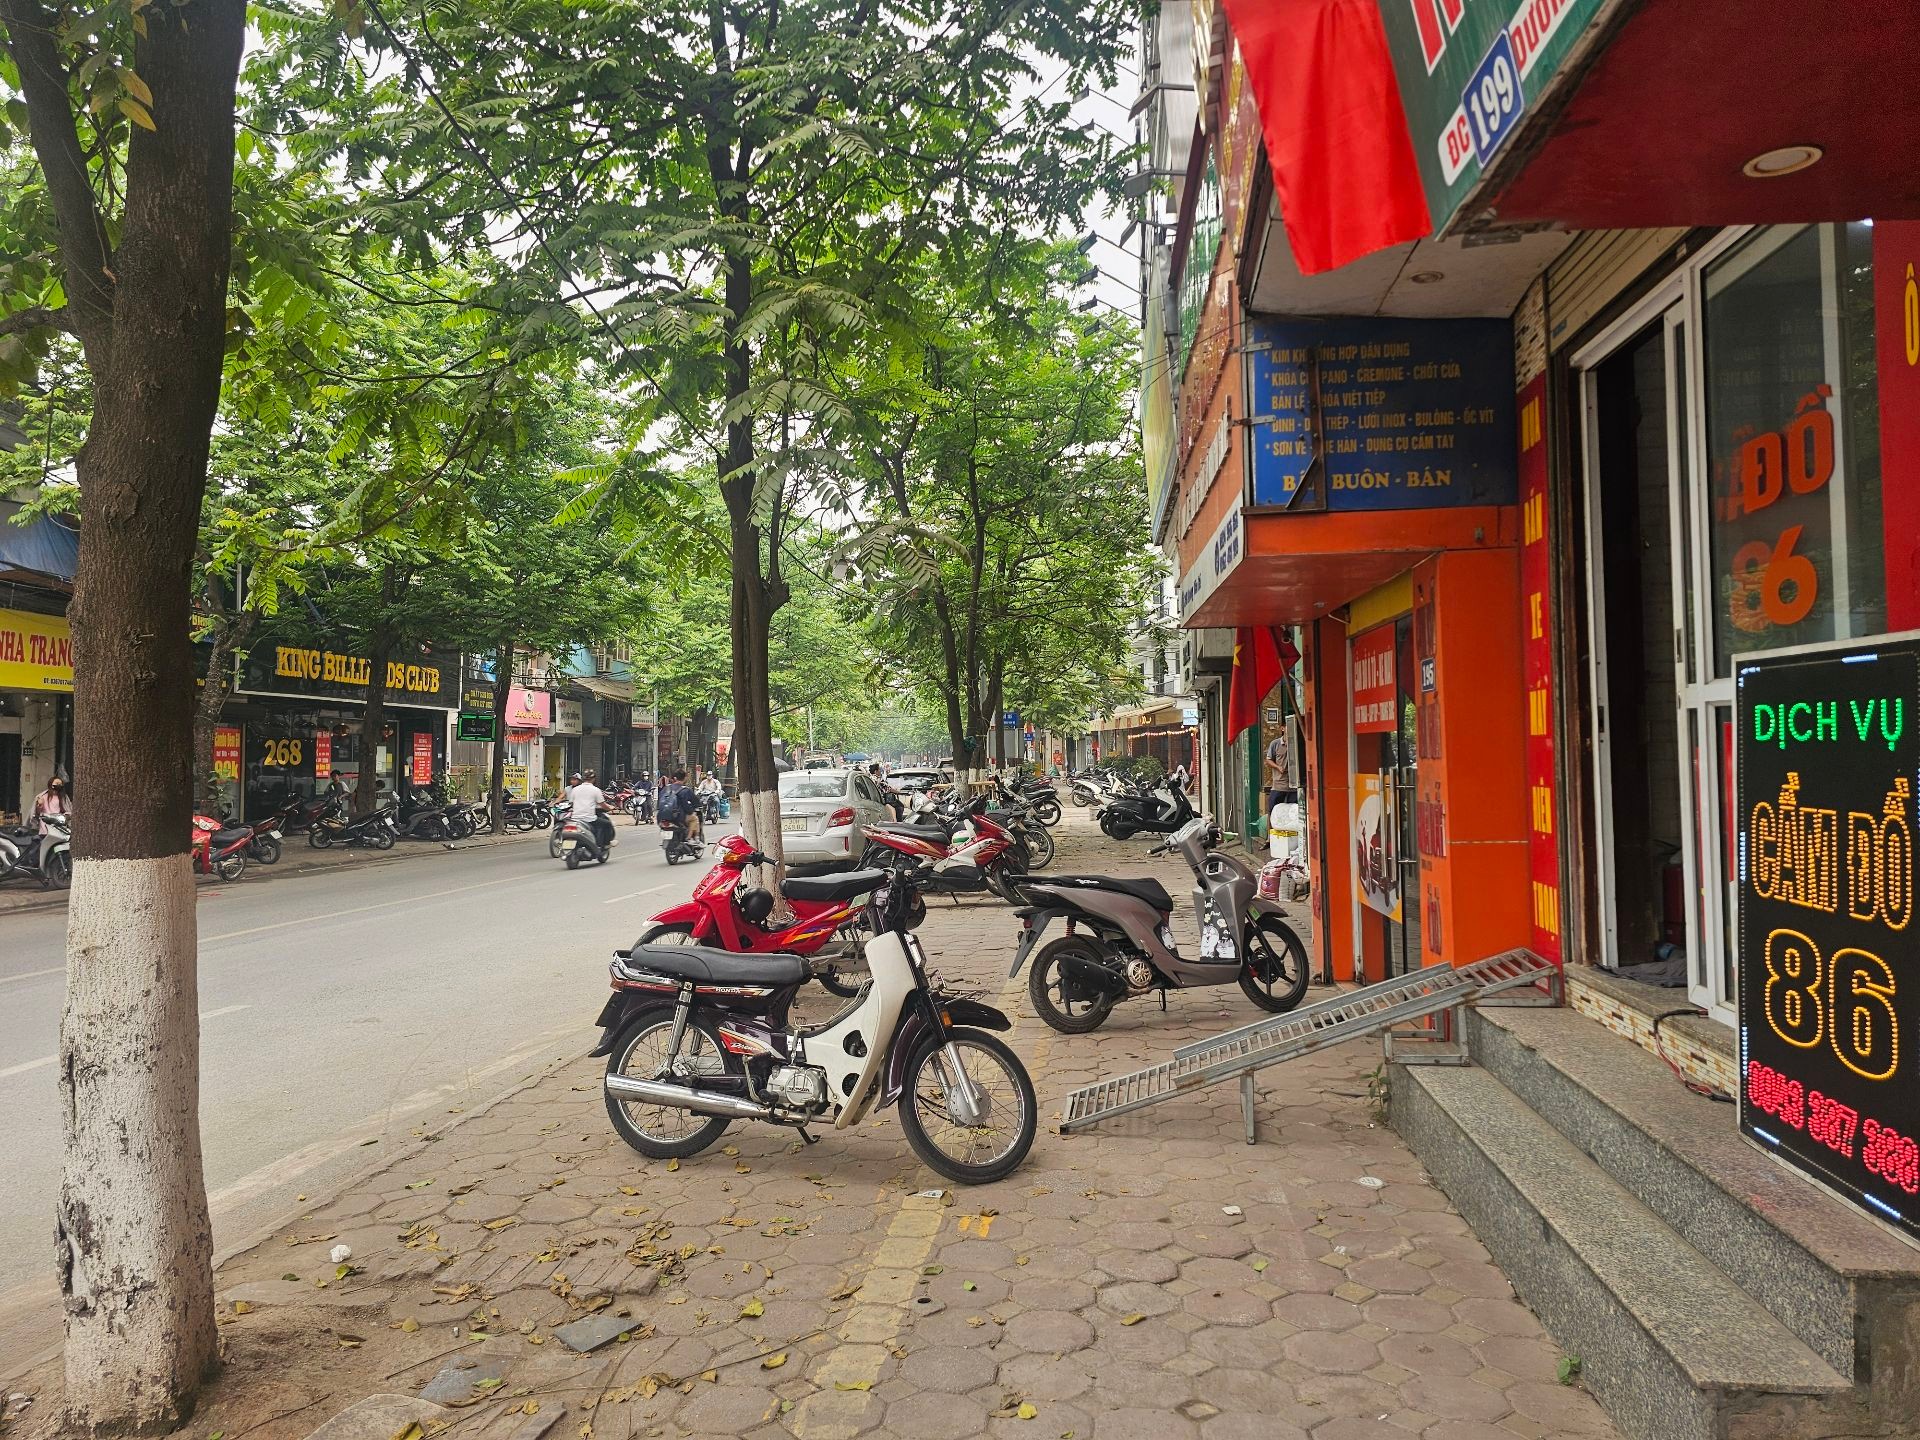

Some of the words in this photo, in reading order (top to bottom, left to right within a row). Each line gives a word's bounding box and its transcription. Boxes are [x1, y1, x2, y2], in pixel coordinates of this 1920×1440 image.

[1446, 115, 1471, 169] ĐC
[1470, 55, 1514, 150] 199
[1271, 350, 1290, 363] KIM
[1338, 345, 1358, 363] HỢP
[1383, 343, 1411, 360] DỤNG
[1356, 367, 1404, 382] CREMONE
[1342, 389, 1362, 408] VIỆT
[1383, 413, 1406, 428] INOX
[1366, 438, 1393, 455] DỤNG
[1396, 437, 1409, 453] CỤ
[1435, 434, 1455, 448] TAY
[1331, 468, 1390, 489] BUÔN
[1406, 466, 1452, 487] BÁN
[1530, 592, 1543, 640] XE
[275, 646, 322, 680] KING
[323, 651, 404, 689] BILLIDS
[406, 665, 440, 692] CLUB
[1754, 703, 1837, 750] DỊCH
[1850, 698, 1902, 751] VỤ
[263, 738, 303, 766] 268
[1764, 928, 1899, 1081] 86
